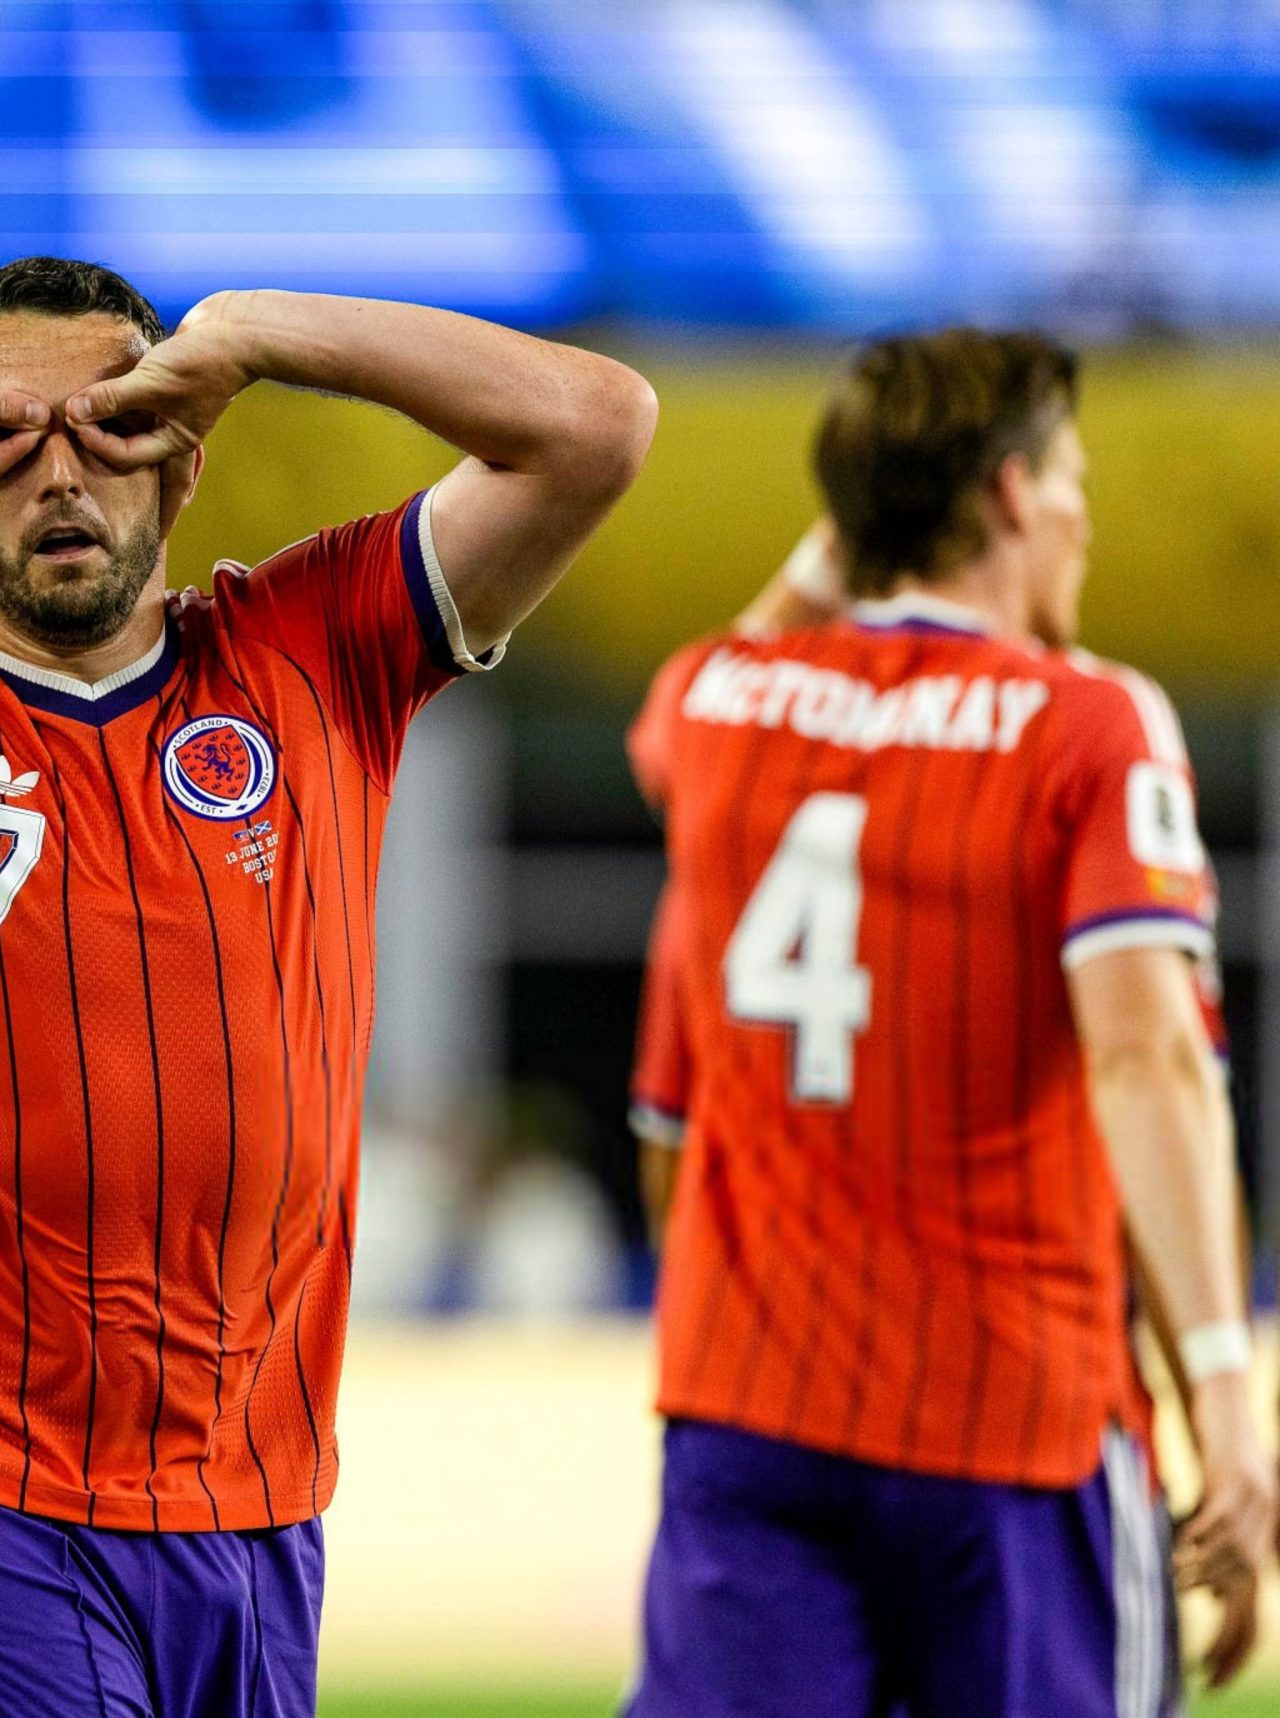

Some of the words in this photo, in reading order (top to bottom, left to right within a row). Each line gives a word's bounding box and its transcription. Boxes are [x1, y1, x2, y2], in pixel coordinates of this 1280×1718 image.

[175, 719, 223, 745] SCOTLAND
[200, 805, 216, 814] EST
[257, 776, 270, 794] 1873
[225, 852, 238, 865] 13
[240, 841, 264, 859] JUNE
[265, 832, 279, 848] 20
[725, 792, 872, 1107] 4
